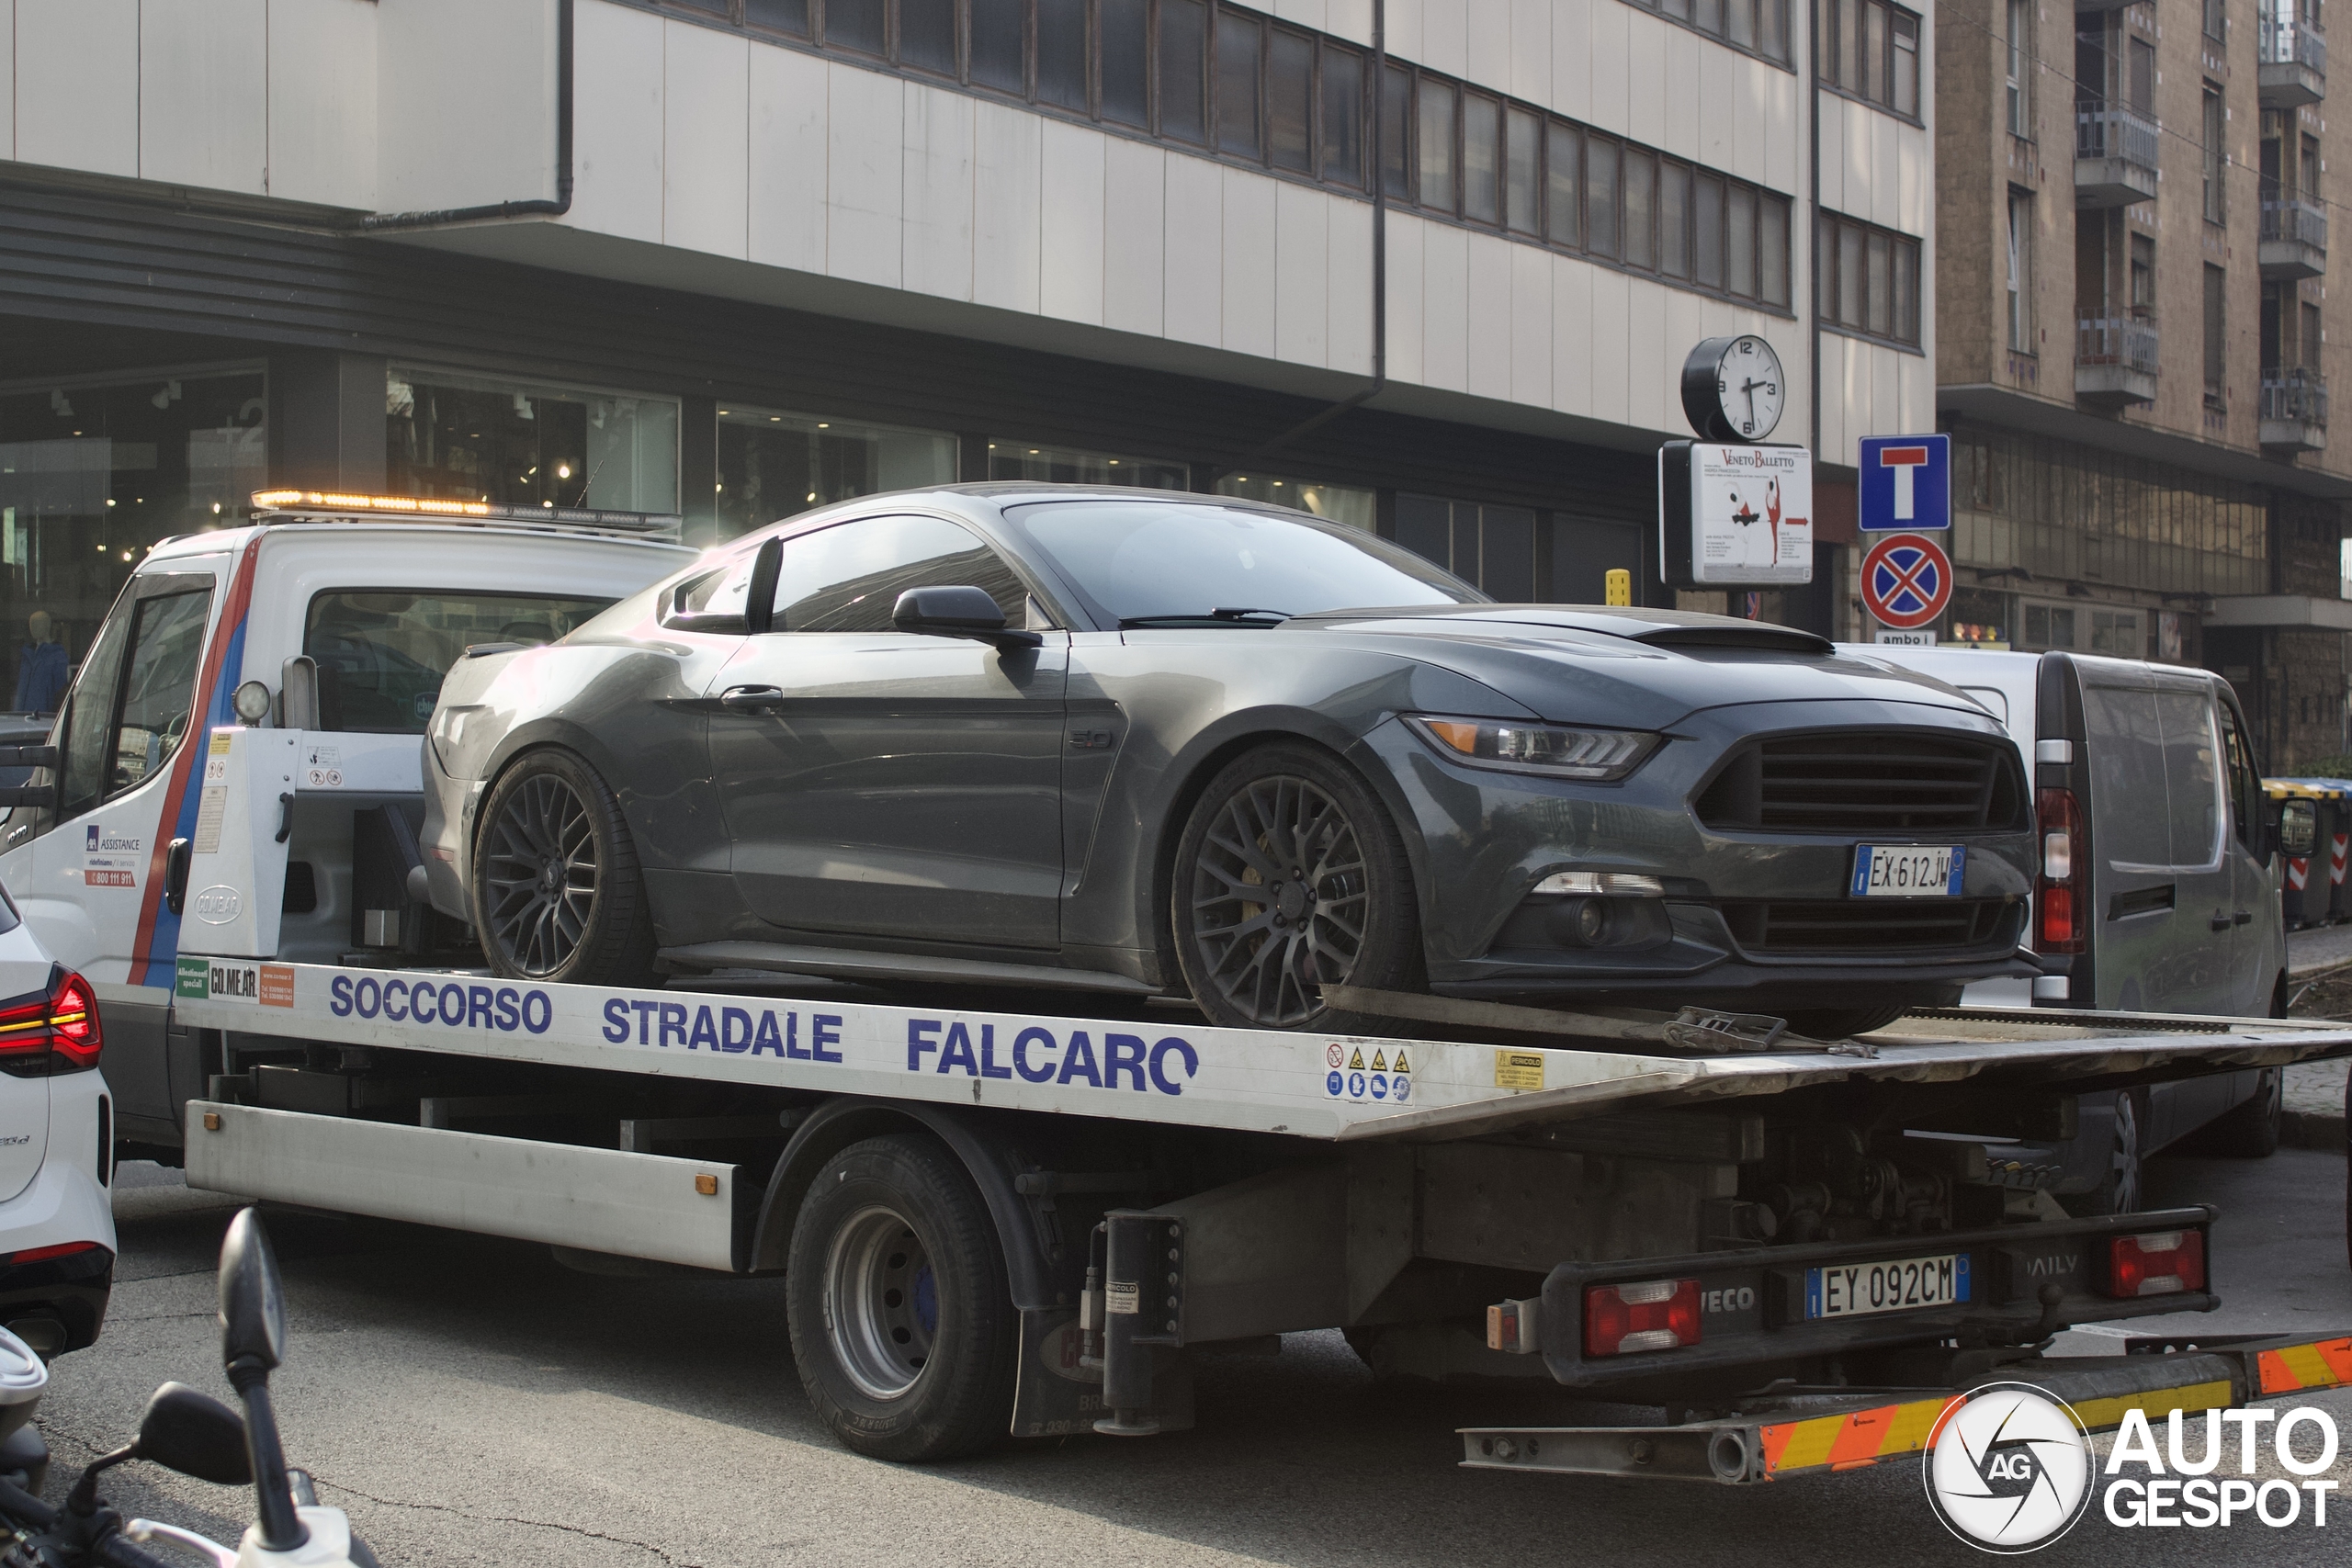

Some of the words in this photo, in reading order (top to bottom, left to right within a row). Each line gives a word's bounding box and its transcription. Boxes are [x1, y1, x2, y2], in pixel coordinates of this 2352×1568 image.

[1740, 341, 1753, 355] 12
[1767, 383, 1777, 396] 3
[1742, 422, 1753, 434] 6
[1883, 634, 1920, 645] ambo
[100, 839, 140, 851] ASSISTANCE
[1871, 856, 1894, 886] EX
[96, 872, 109, 884] 800
[110, 873, 119, 885] 111
[121, 873, 131, 885] 911
[183, 979, 202, 988] speciali
[210, 967, 257, 998] CO.ME.AR.
[330, 976, 552, 1034] SOCCORSO
[602, 998, 843, 1063] STRADALE
[908, 1019, 1199, 1096] FALCARO
[1826, 1268, 1859, 1313] EY
[1870, 1258, 1952, 1307] 092CM
